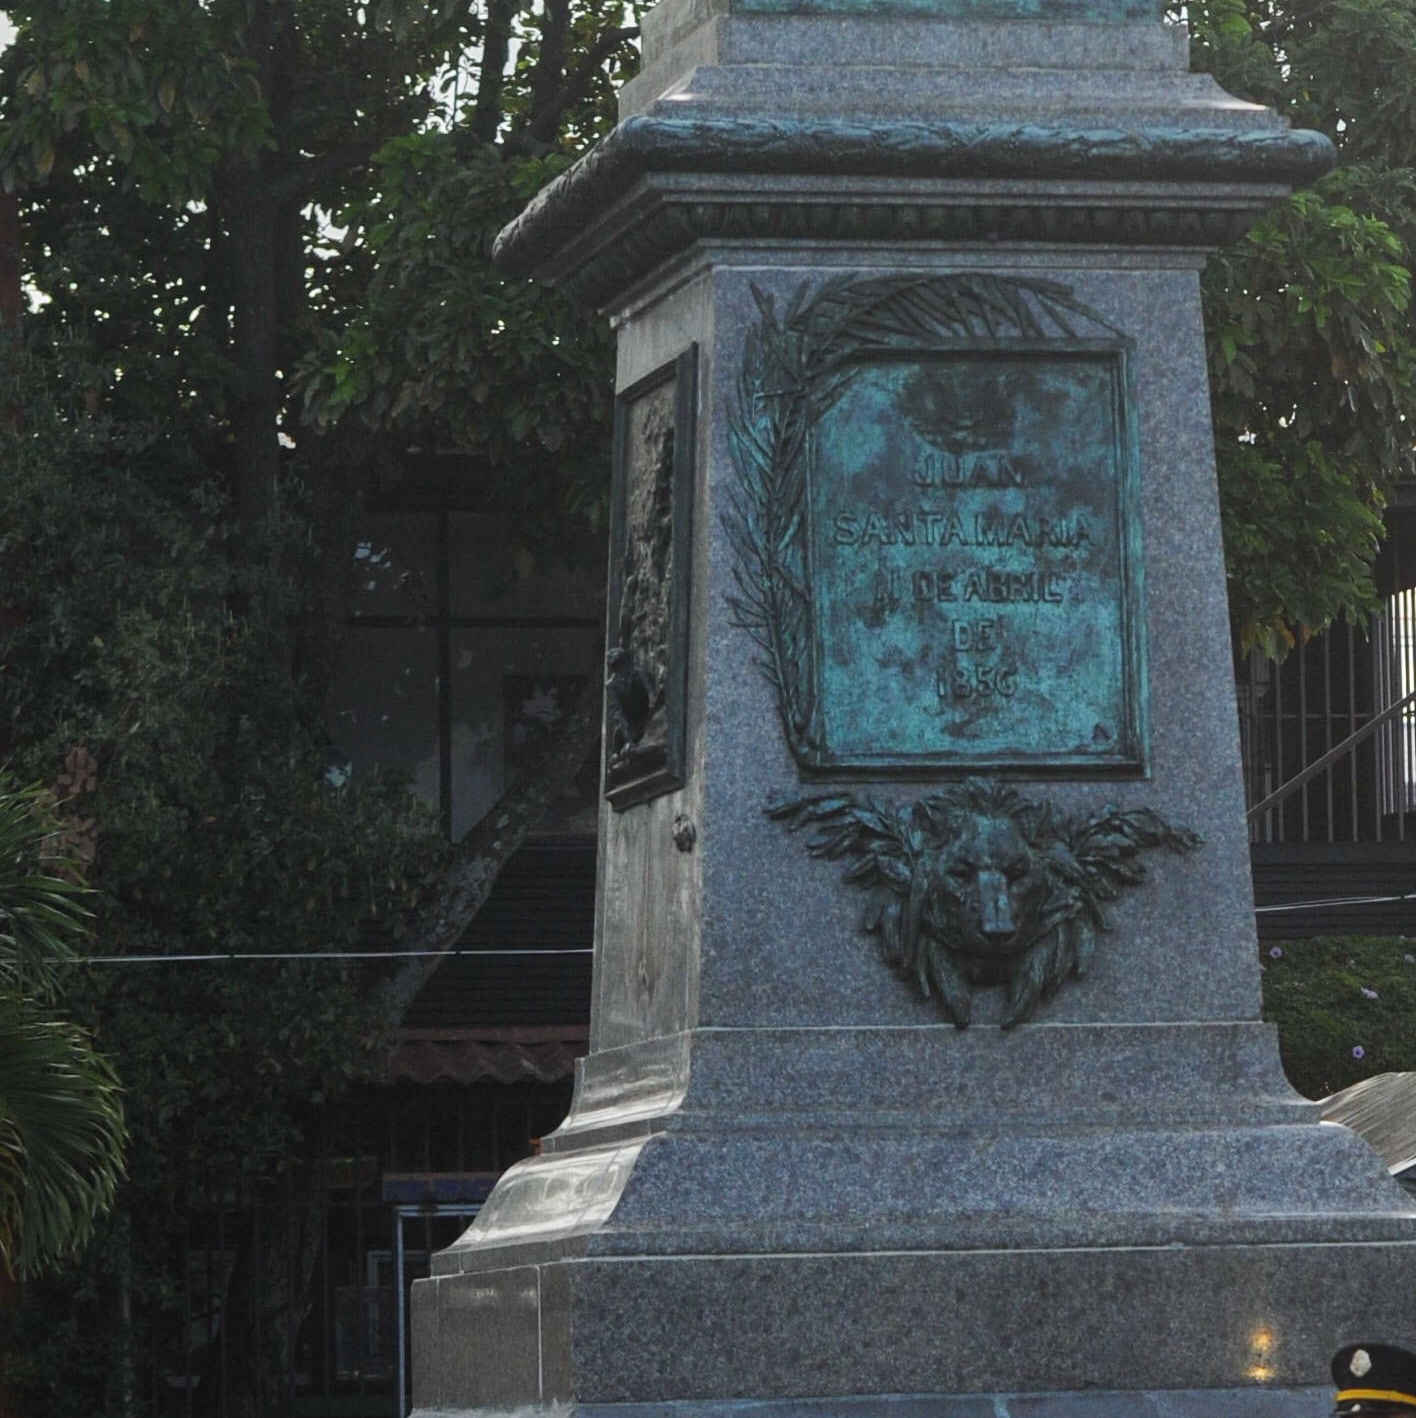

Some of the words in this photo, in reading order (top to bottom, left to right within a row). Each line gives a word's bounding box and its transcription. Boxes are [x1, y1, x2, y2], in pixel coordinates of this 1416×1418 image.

[914, 455, 1025, 487] JUAN
[874, 569, 900, 602] 11
[912, 571, 957, 603] DE
[963, 571, 1062, 603] ABRIL
[952, 620, 995, 652] DE
[934, 667, 1018, 698] 1856
